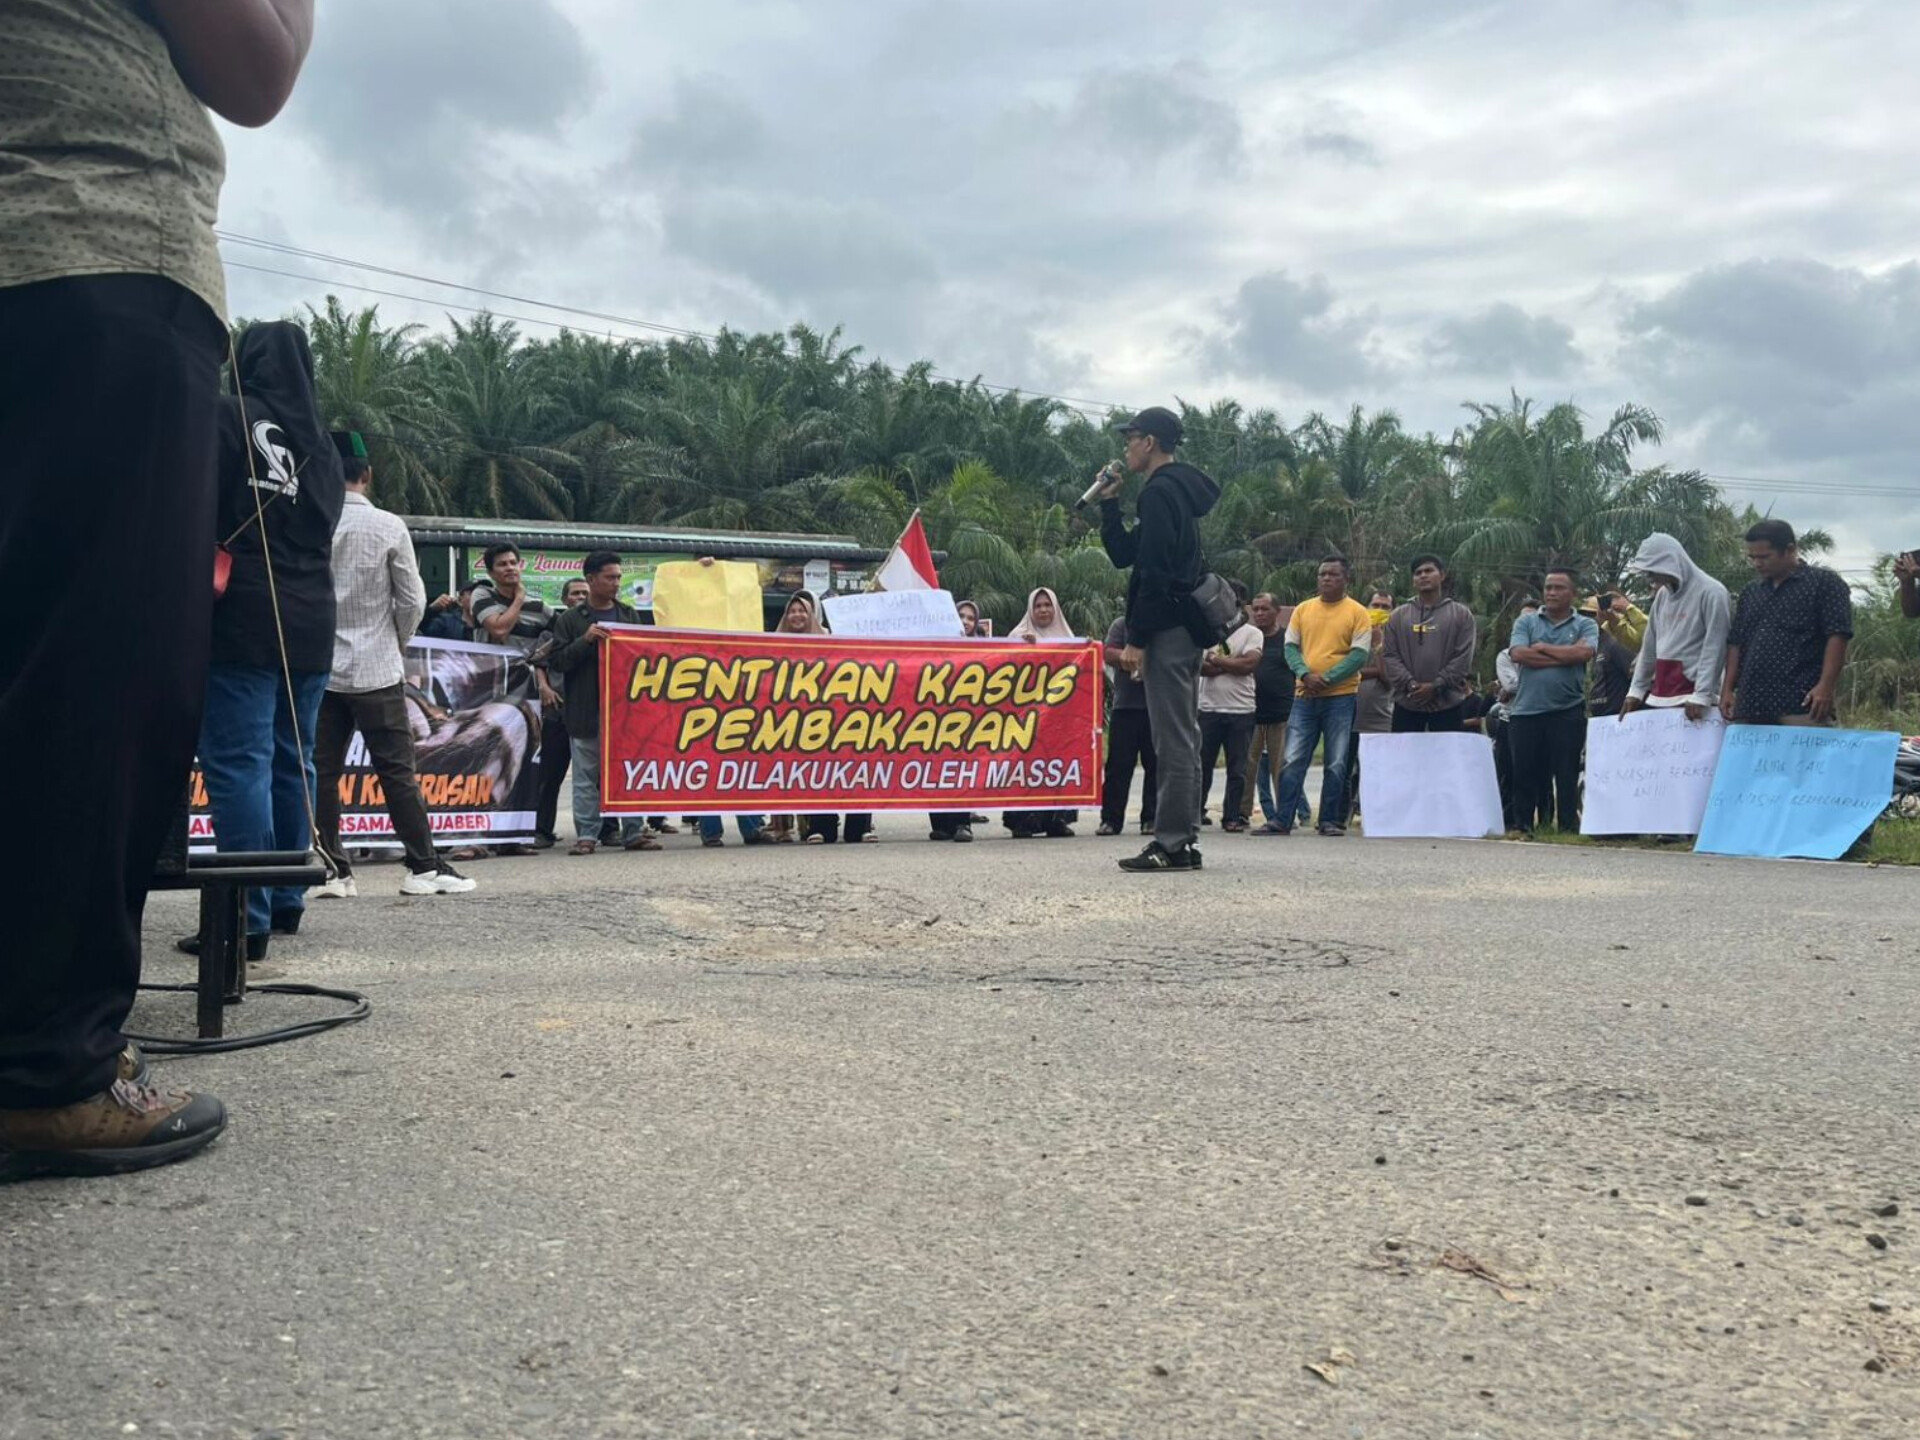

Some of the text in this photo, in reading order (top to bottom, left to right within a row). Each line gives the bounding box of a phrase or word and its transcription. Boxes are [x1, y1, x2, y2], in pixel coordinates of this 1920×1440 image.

[533, 552, 586, 573] Laund
[629, 655, 1080, 706] HENTIKAN KASUS
[677, 705, 1038, 753] PEMBAKARAN
[623, 758, 1083, 791] YANG DILAKUKAN OLEH MASSA
